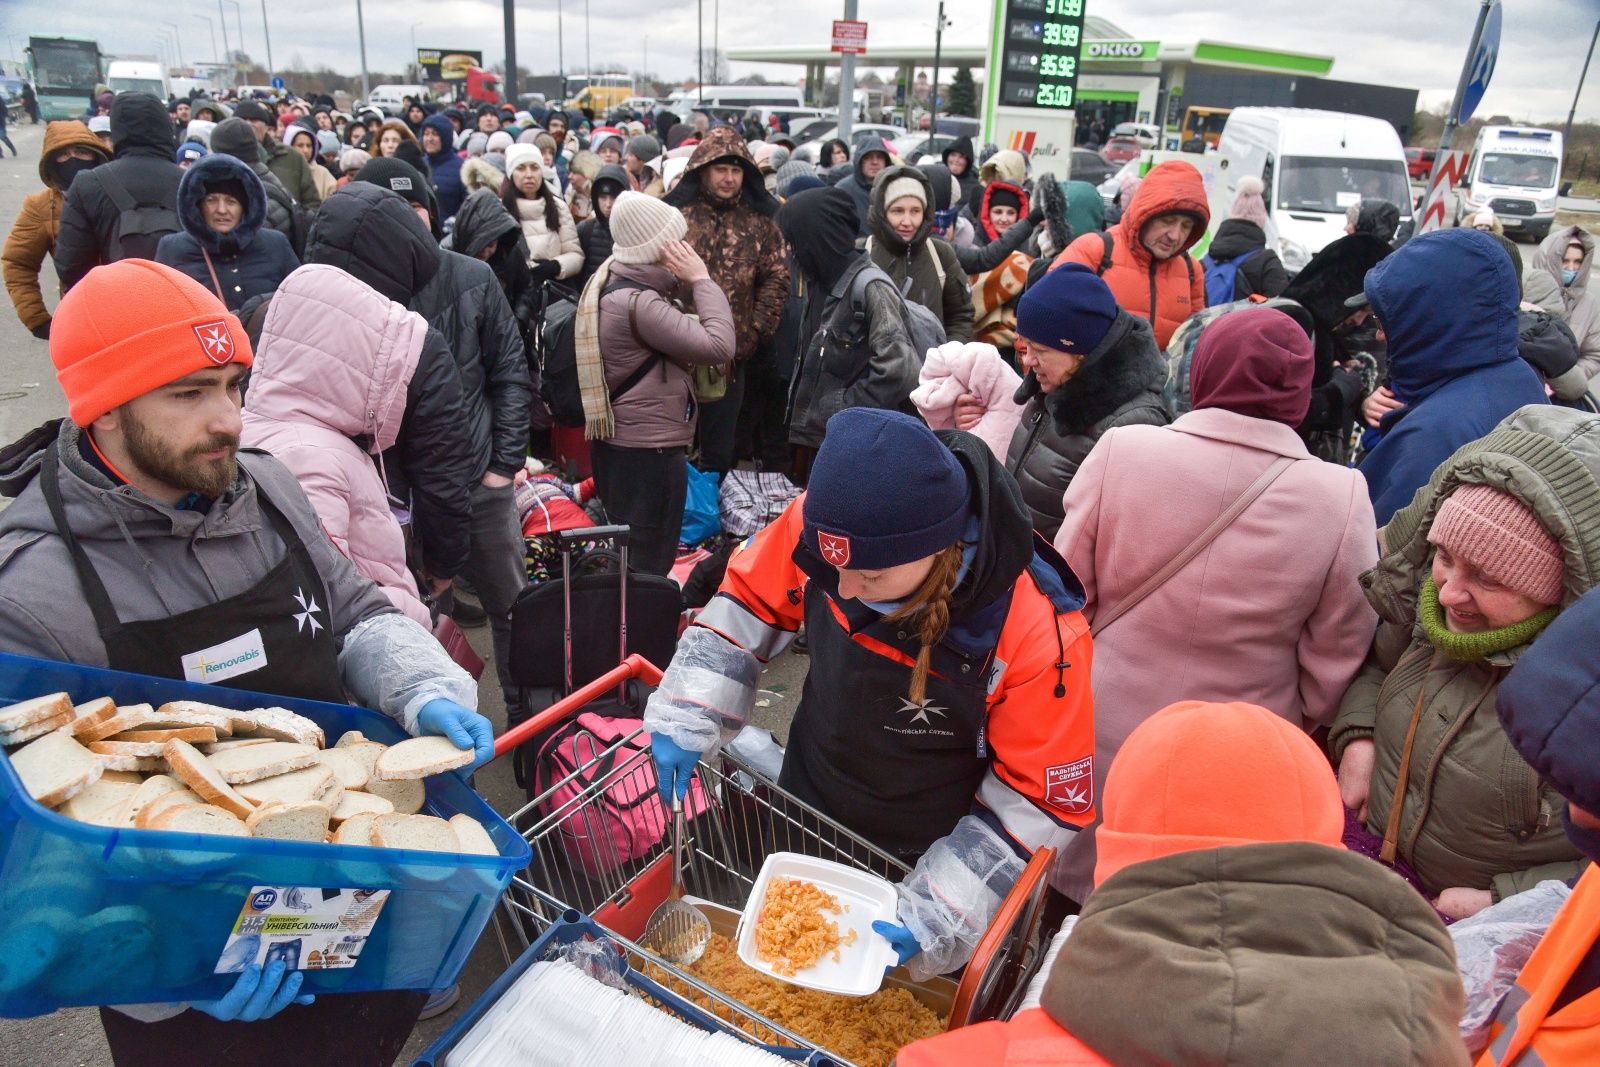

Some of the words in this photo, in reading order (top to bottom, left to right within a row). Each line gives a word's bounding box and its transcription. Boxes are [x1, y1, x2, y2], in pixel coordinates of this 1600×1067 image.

[1043, 23, 1079, 46] 39.99
[1088, 43, 1143, 56] OKKO
[1037, 84, 1072, 106] 25.00
[205, 649, 259, 673] Renovabis
[1050, 760, 1091, 776] МАЛЬТІЙСЬКА
[1059, 770, 1083, 780] СЛУЖБА
[242, 917, 266, 926] 31,5
[266, 921, 339, 930] УНІВЕРСАЛЬНИЙ
